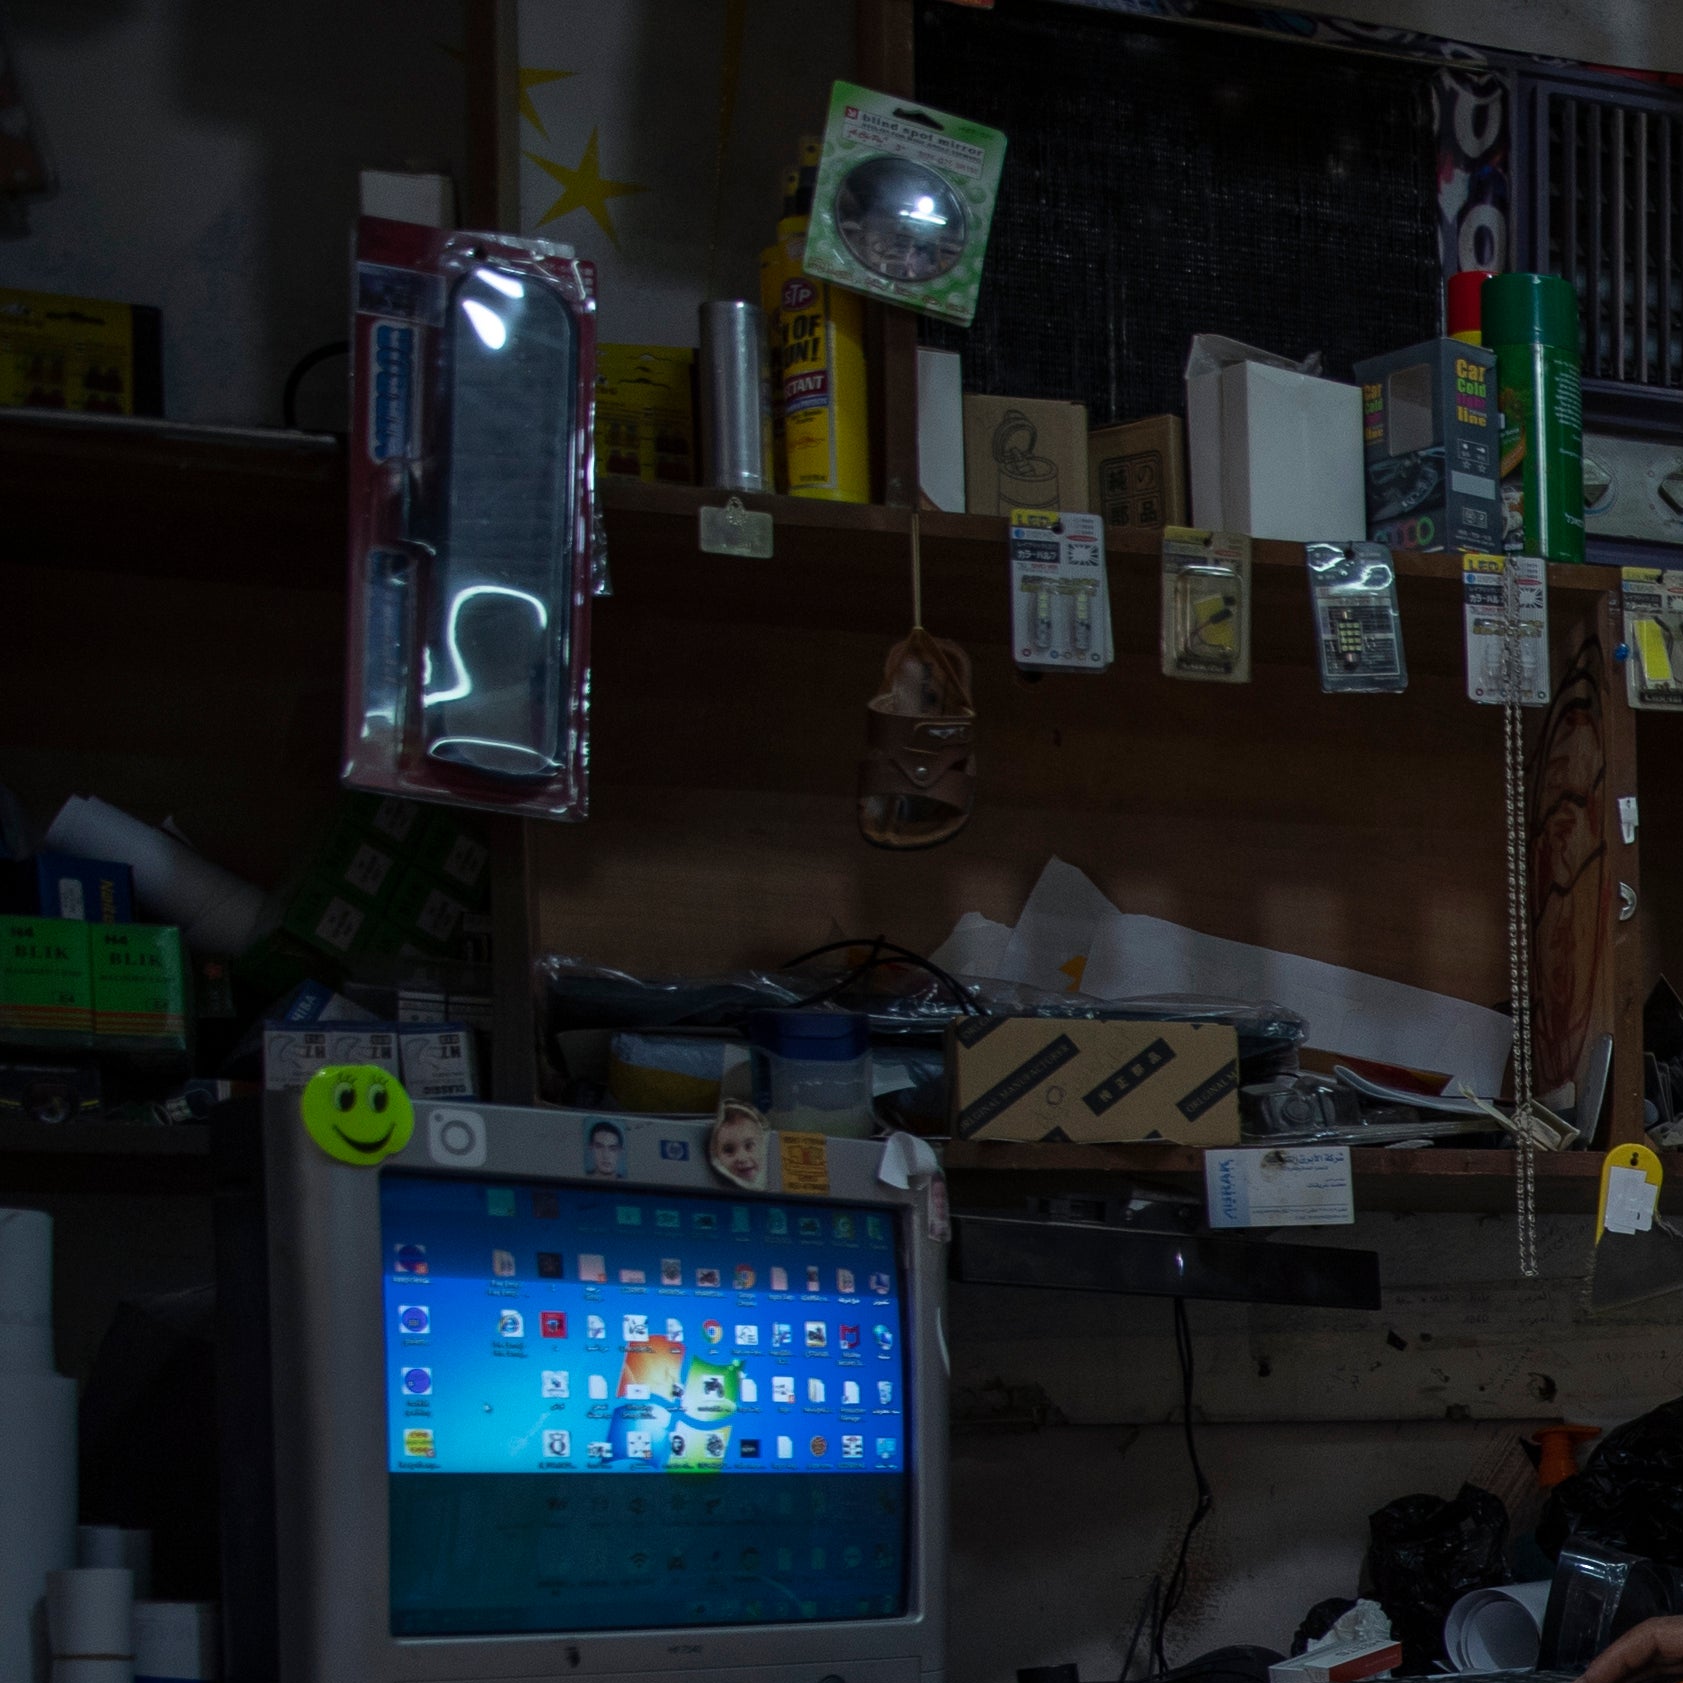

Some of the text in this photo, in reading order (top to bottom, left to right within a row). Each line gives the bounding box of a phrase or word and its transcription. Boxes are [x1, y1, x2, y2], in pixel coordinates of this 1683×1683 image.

[862, 113, 900, 133] blind
[903, 124, 934, 145] spot
[937, 135, 983, 156] mirror
[785, 284, 812, 306] STP
[1456, 358, 1487, 382] Car
[1456, 378, 1487, 398] Cold
[1456, 406, 1487, 427] line
[1468, 558, 1499, 571] LED
[15, 945, 68, 959] BLIK
